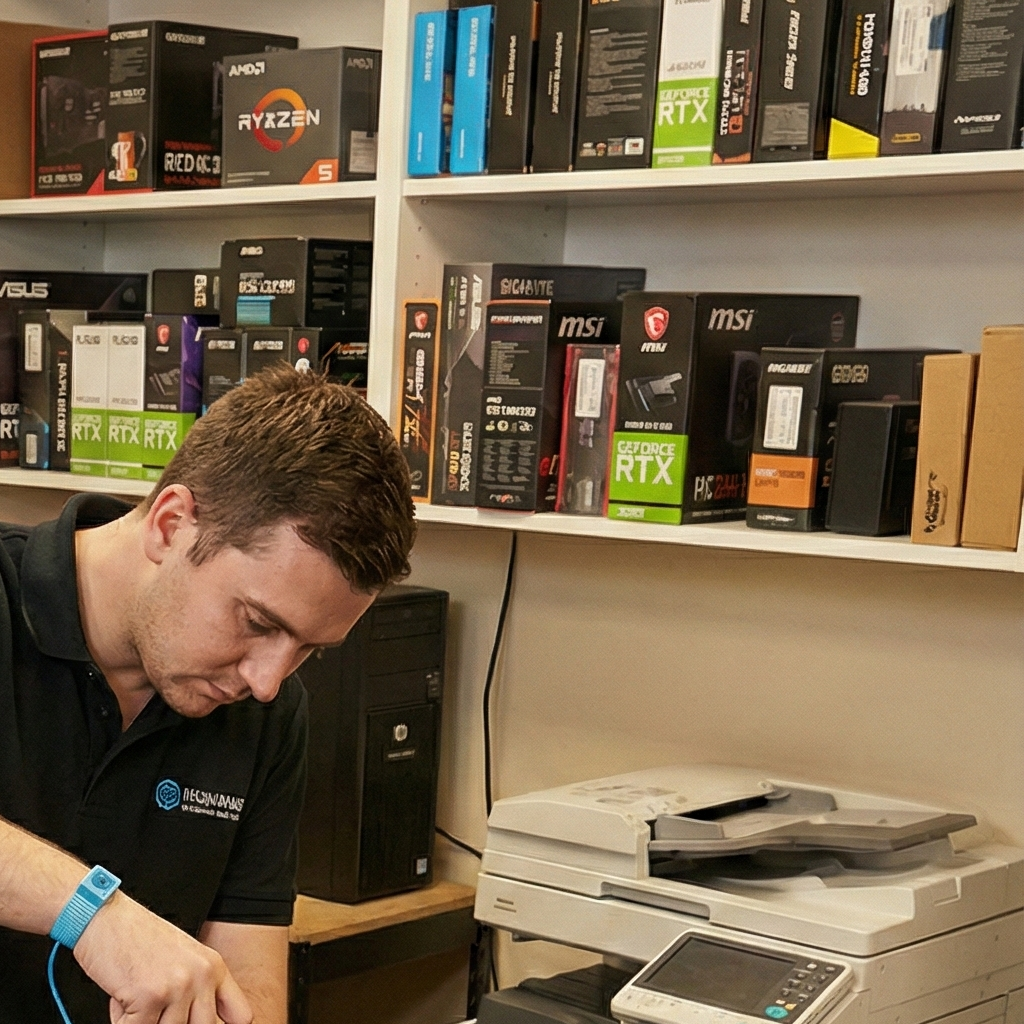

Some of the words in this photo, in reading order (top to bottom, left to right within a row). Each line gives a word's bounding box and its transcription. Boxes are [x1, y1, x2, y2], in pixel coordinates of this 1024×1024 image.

[229, 62, 260, 77] AMD
[658, 99, 709, 126] RTX
[558, 314, 605, 338] msi
[708, 307, 755, 331] msi
[72, 422, 101, 442] RTX
[108, 424, 139, 445] RTX
[144, 428, 177, 450] RTX
[616, 455, 674, 485] RTX
